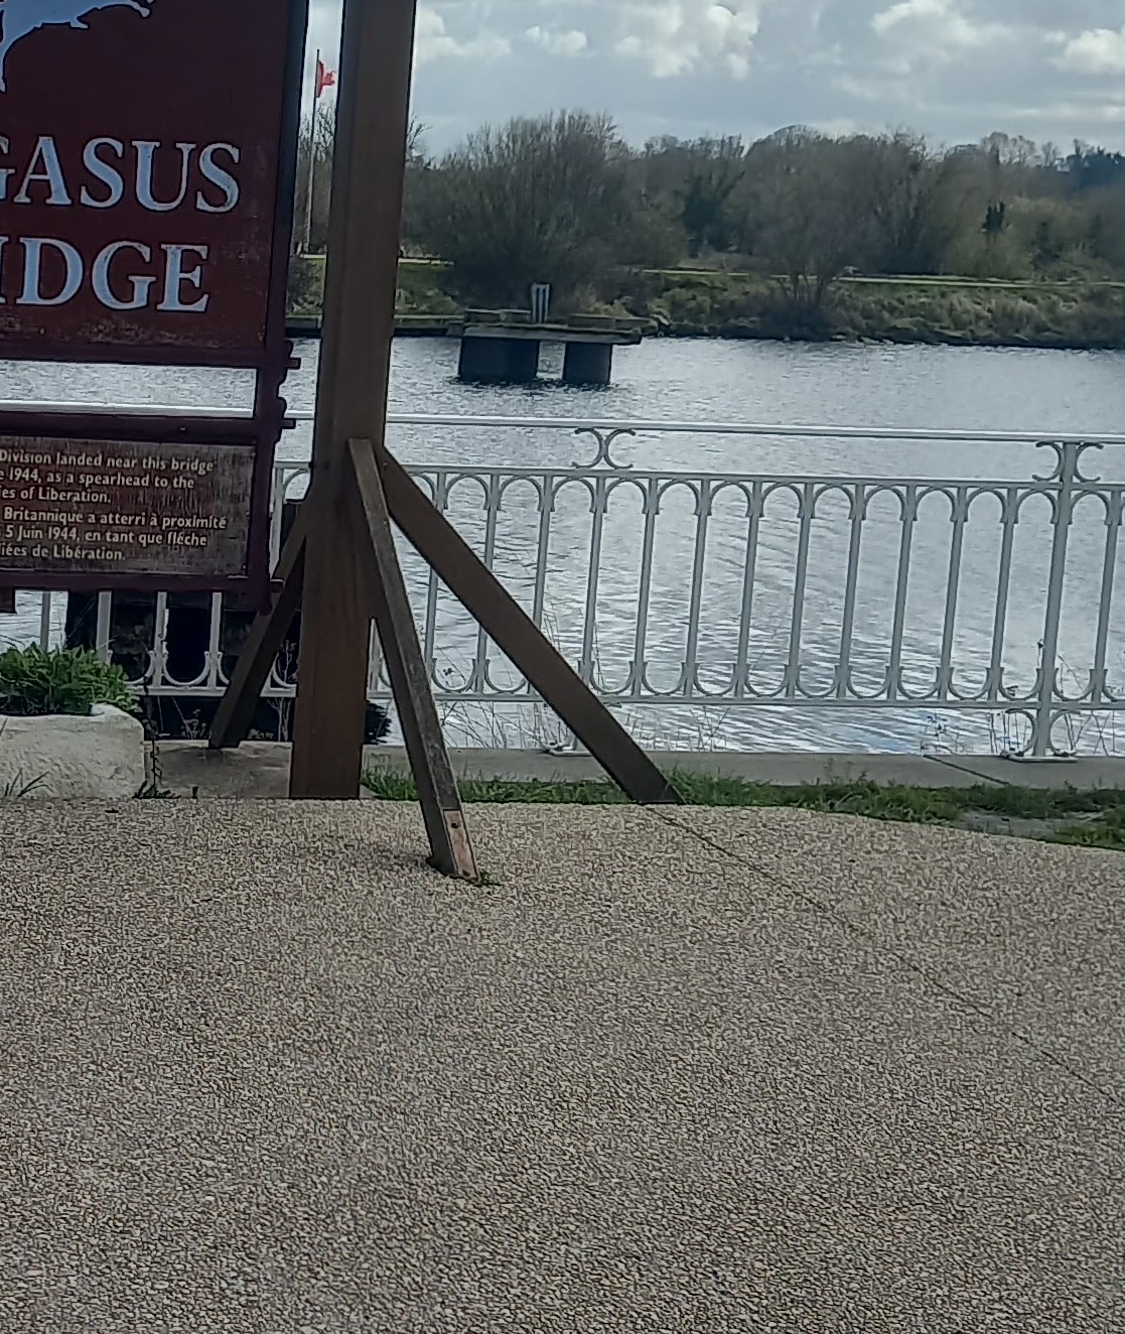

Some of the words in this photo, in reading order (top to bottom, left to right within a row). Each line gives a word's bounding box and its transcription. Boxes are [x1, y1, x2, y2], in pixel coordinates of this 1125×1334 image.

[56, 451, 103, 467] landed
[107, 457, 138, 468] near
[142, 456, 166, 470] this
[171, 457, 214, 476] bridge
[8, 467, 42, 484] 1944,
[46, 472, 62, 484] as
[66, 473, 74, 484] a
[78, 471, 150, 488] spearhead
[154, 475, 168, 488] to
[172, 475, 195, 489] the
[20, 486, 35, 500] of
[38, 487, 111, 504] Liberation.
[4, 506, 84, 526] Britannique
[87, 514, 96, 525] a
[100, 512, 146, 526] atterri
[162, 515, 227, 531] proximité
[5, 525, 15, 539] 5
[16, 526, 44, 542] Juin
[48, 526, 81, 543] 1944,
[84, 531, 101, 542] en
[105, 531, 135, 544] tant
[138, 533, 163, 548] que
[32, 544, 49, 558] de
[53, 545, 126, 562] Libération.
